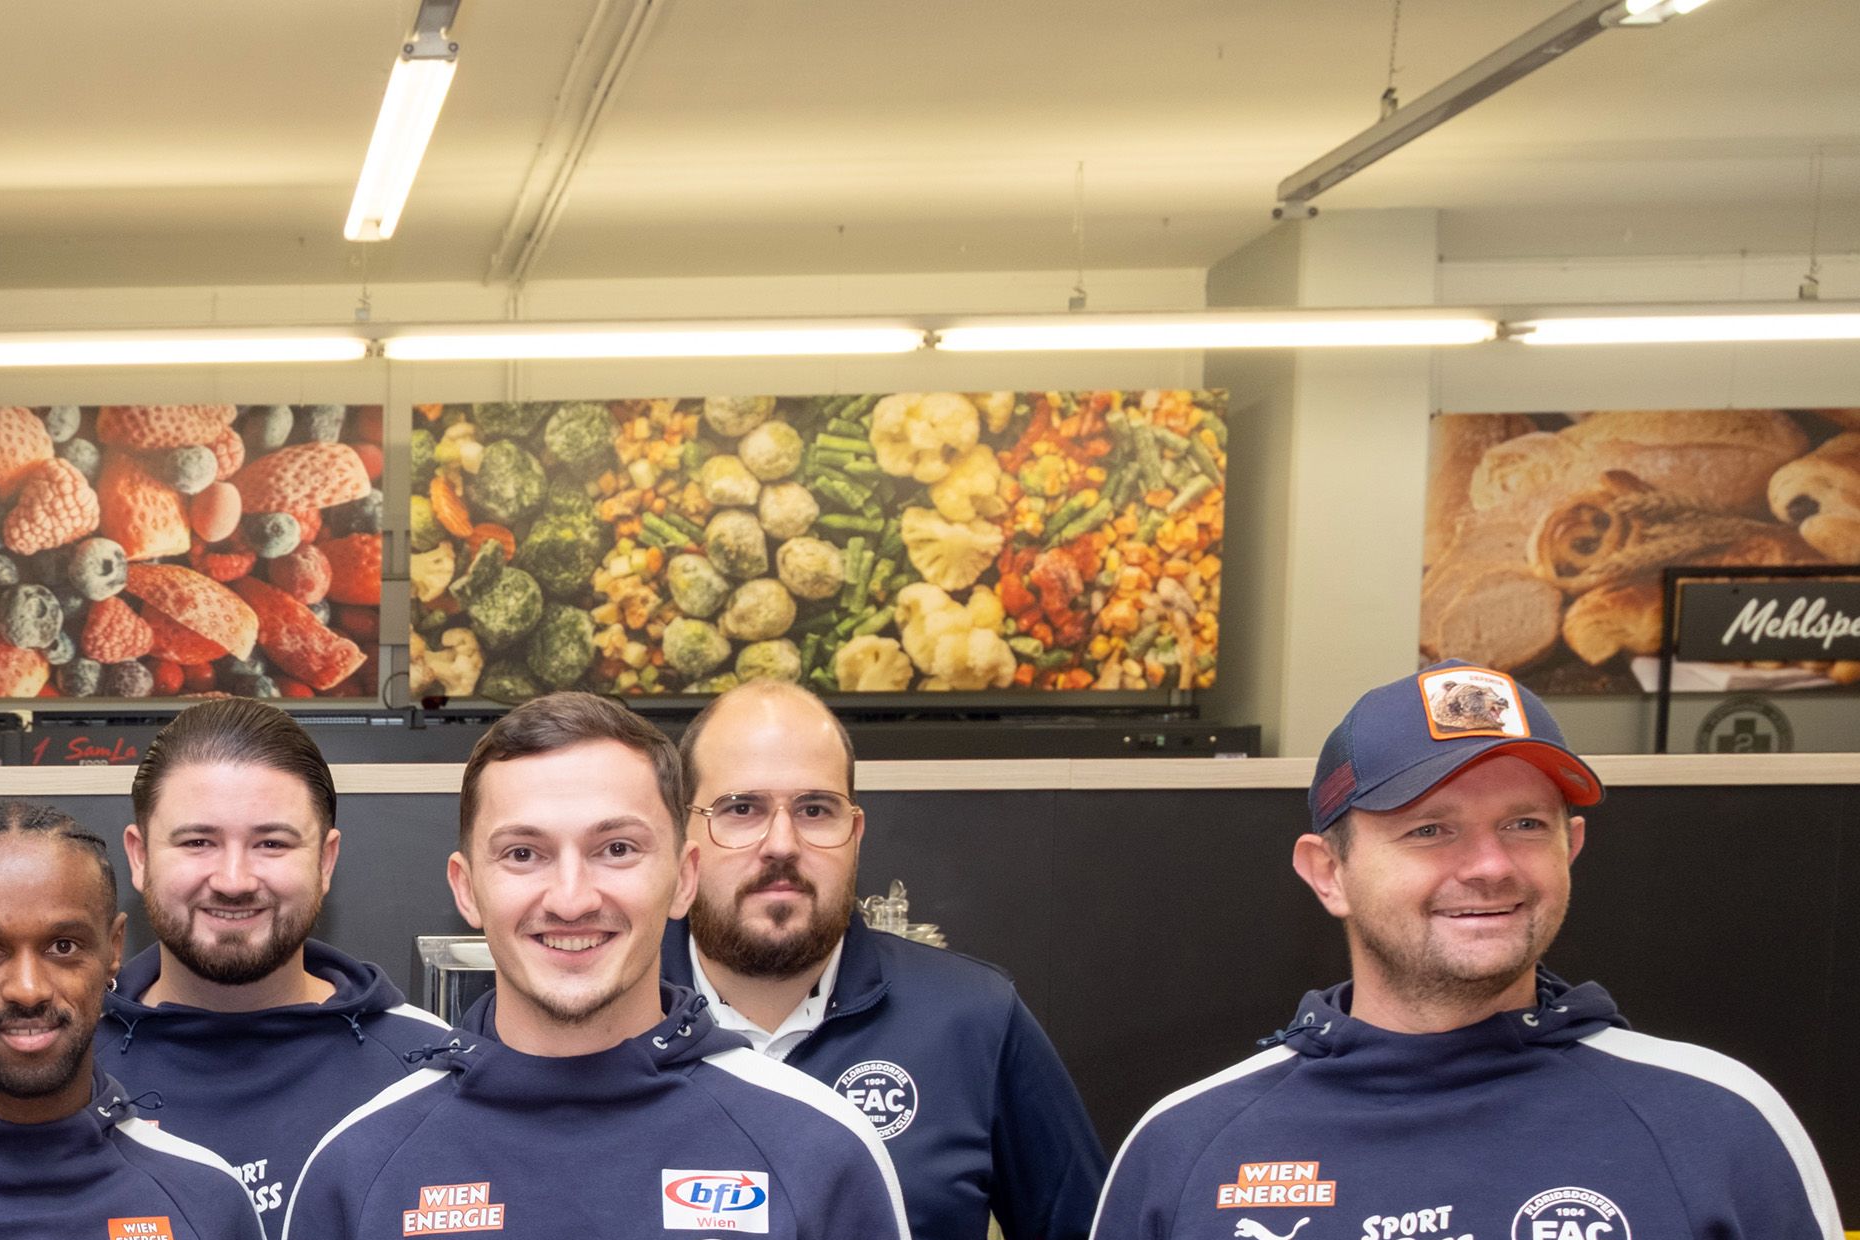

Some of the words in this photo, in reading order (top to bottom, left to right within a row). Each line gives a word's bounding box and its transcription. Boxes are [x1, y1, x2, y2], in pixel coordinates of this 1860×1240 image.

[1243, 1164, 1315, 1182] WIEN
[423, 1185, 486, 1206] WIEN
[690, 1182, 741, 1213] bfi
[1218, 1183, 1332, 1205] ENERGIE
[123, 1222, 158, 1234] WIEN
[404, 1207, 501, 1233] ENERGIE
[697, 1217, 736, 1229] Wien
